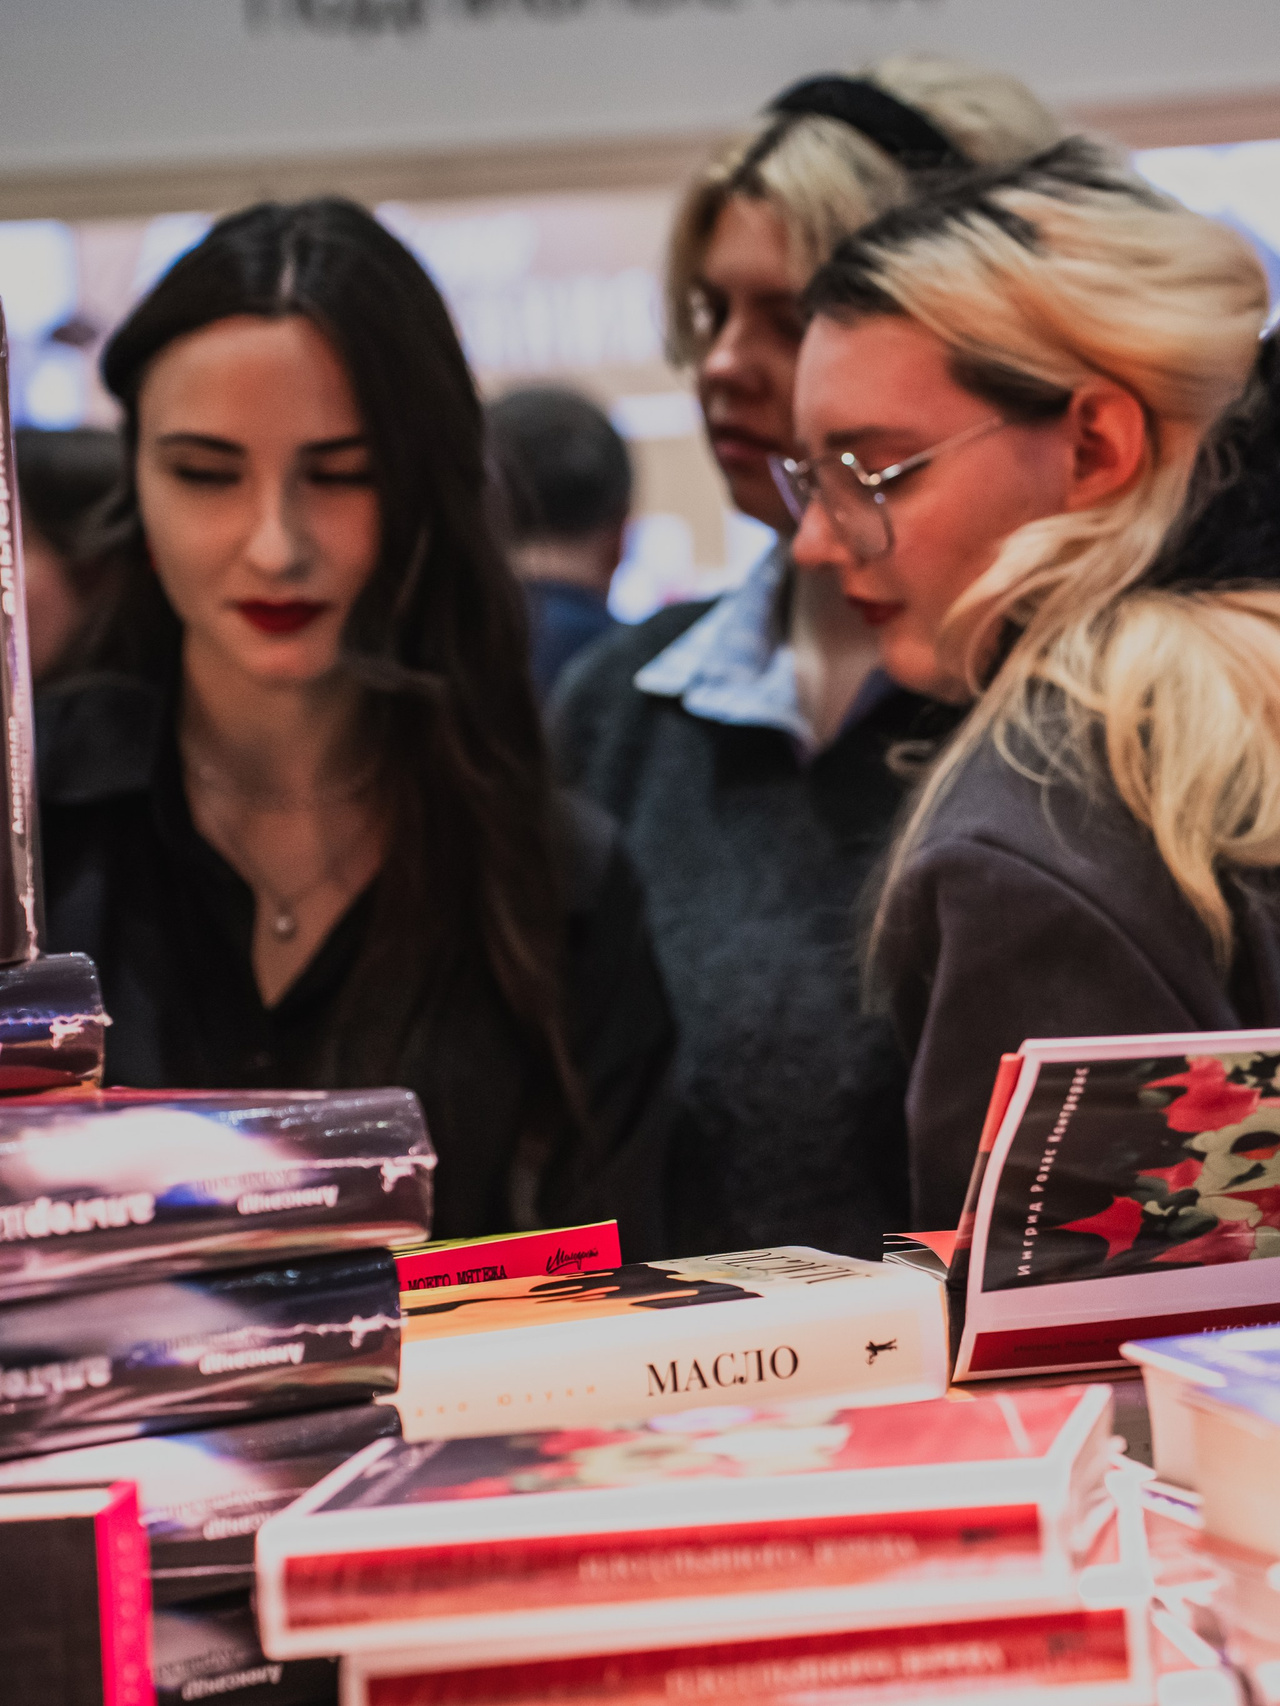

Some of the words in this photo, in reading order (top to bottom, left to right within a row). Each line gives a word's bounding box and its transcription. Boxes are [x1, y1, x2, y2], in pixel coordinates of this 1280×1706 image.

[1046, 1066, 1091, 1143] Контрерас
[1028, 1148, 1059, 1193] Рохас
[1016, 1201, 1043, 1276] Ингрид
[408, 1274, 452, 1292] МОЕГО
[457, 1265, 508, 1285] МЯТЕЖА
[645, 1345, 800, 1397] МАСЛО
